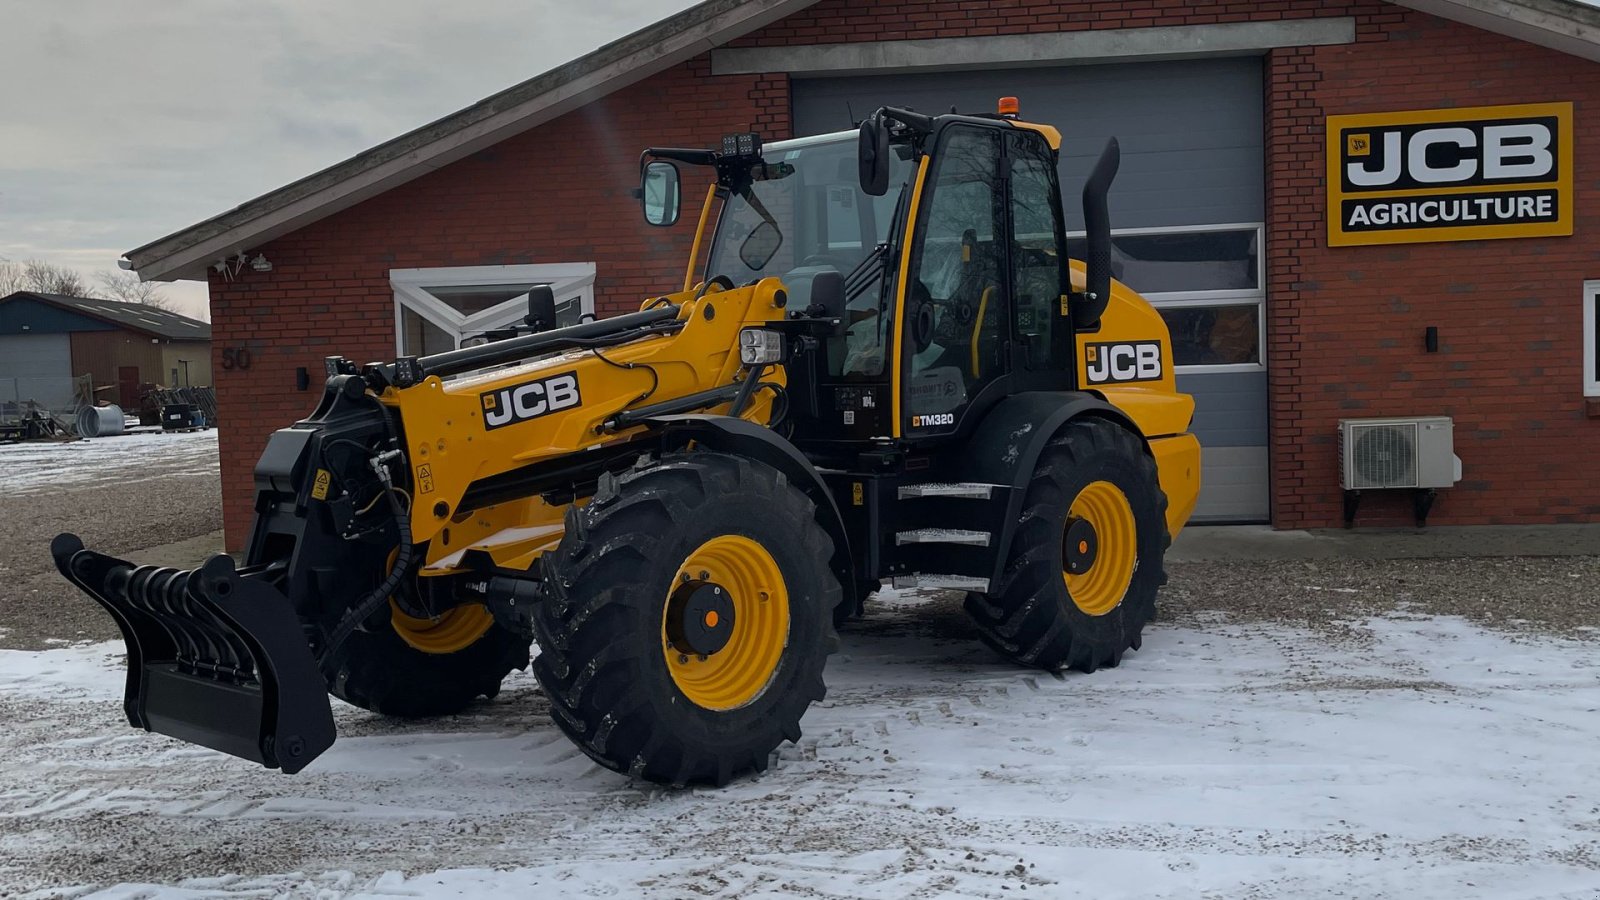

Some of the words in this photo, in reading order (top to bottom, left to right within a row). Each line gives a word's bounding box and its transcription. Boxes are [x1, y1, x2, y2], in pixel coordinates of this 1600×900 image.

[1347, 123, 1553, 186] JCB
[1348, 195, 1552, 226] AGRICULTURE
[222, 347, 251, 370] 50
[1087, 343, 1161, 382] JCB
[486, 375, 579, 426] JCB
[919, 413, 954, 427] TM320
